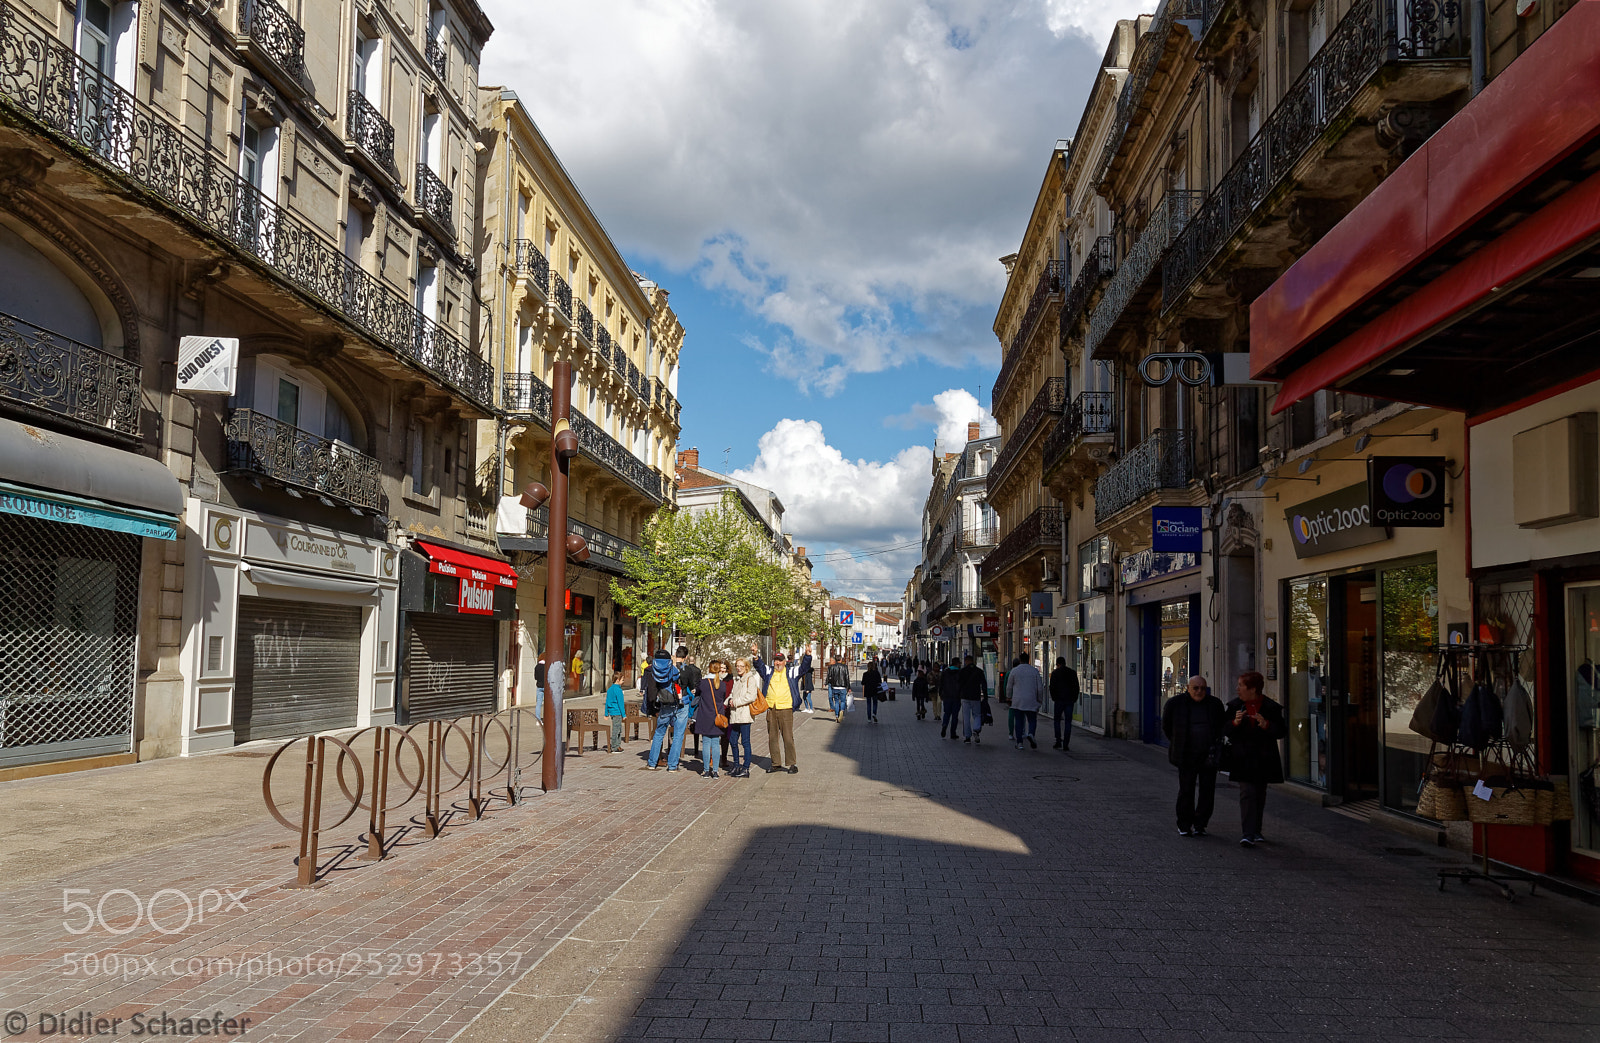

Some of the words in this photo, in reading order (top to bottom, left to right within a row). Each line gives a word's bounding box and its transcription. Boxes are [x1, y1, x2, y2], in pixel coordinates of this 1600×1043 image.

[178, 362, 199, 384] SUD
[194, 339, 225, 368] OUEST
[1377, 509, 1411, 522] Optic
[1169, 524, 1200, 533] Ociane
[1300, 511, 1336, 544] Optic
[438, 562, 456, 574] Pulsion
[471, 569, 487, 580] Pulsion
[500, 576, 513, 586] Pulsion
[461, 579, 494, 610] Pulsion
[986, 620, 999, 628] SFR
